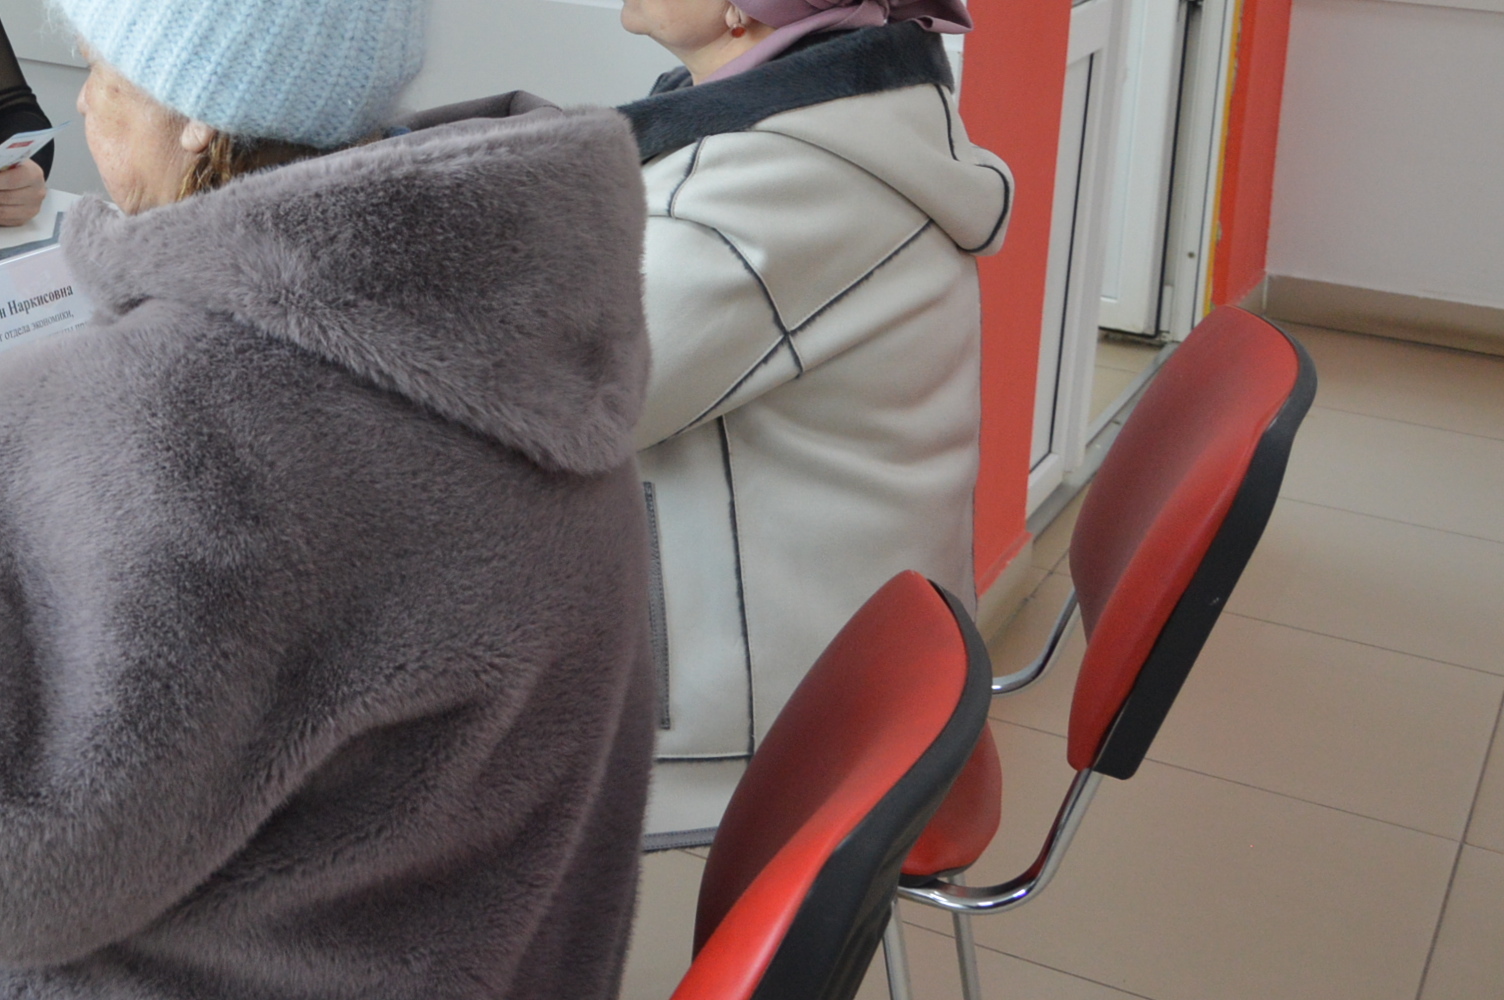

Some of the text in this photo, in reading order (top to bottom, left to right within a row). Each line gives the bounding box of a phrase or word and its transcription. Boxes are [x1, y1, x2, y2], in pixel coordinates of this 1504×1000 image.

[7, 285, 74, 316] Наркисовна
[4, 325, 31, 342] отдела
[31, 309, 74, 332] экономики,
